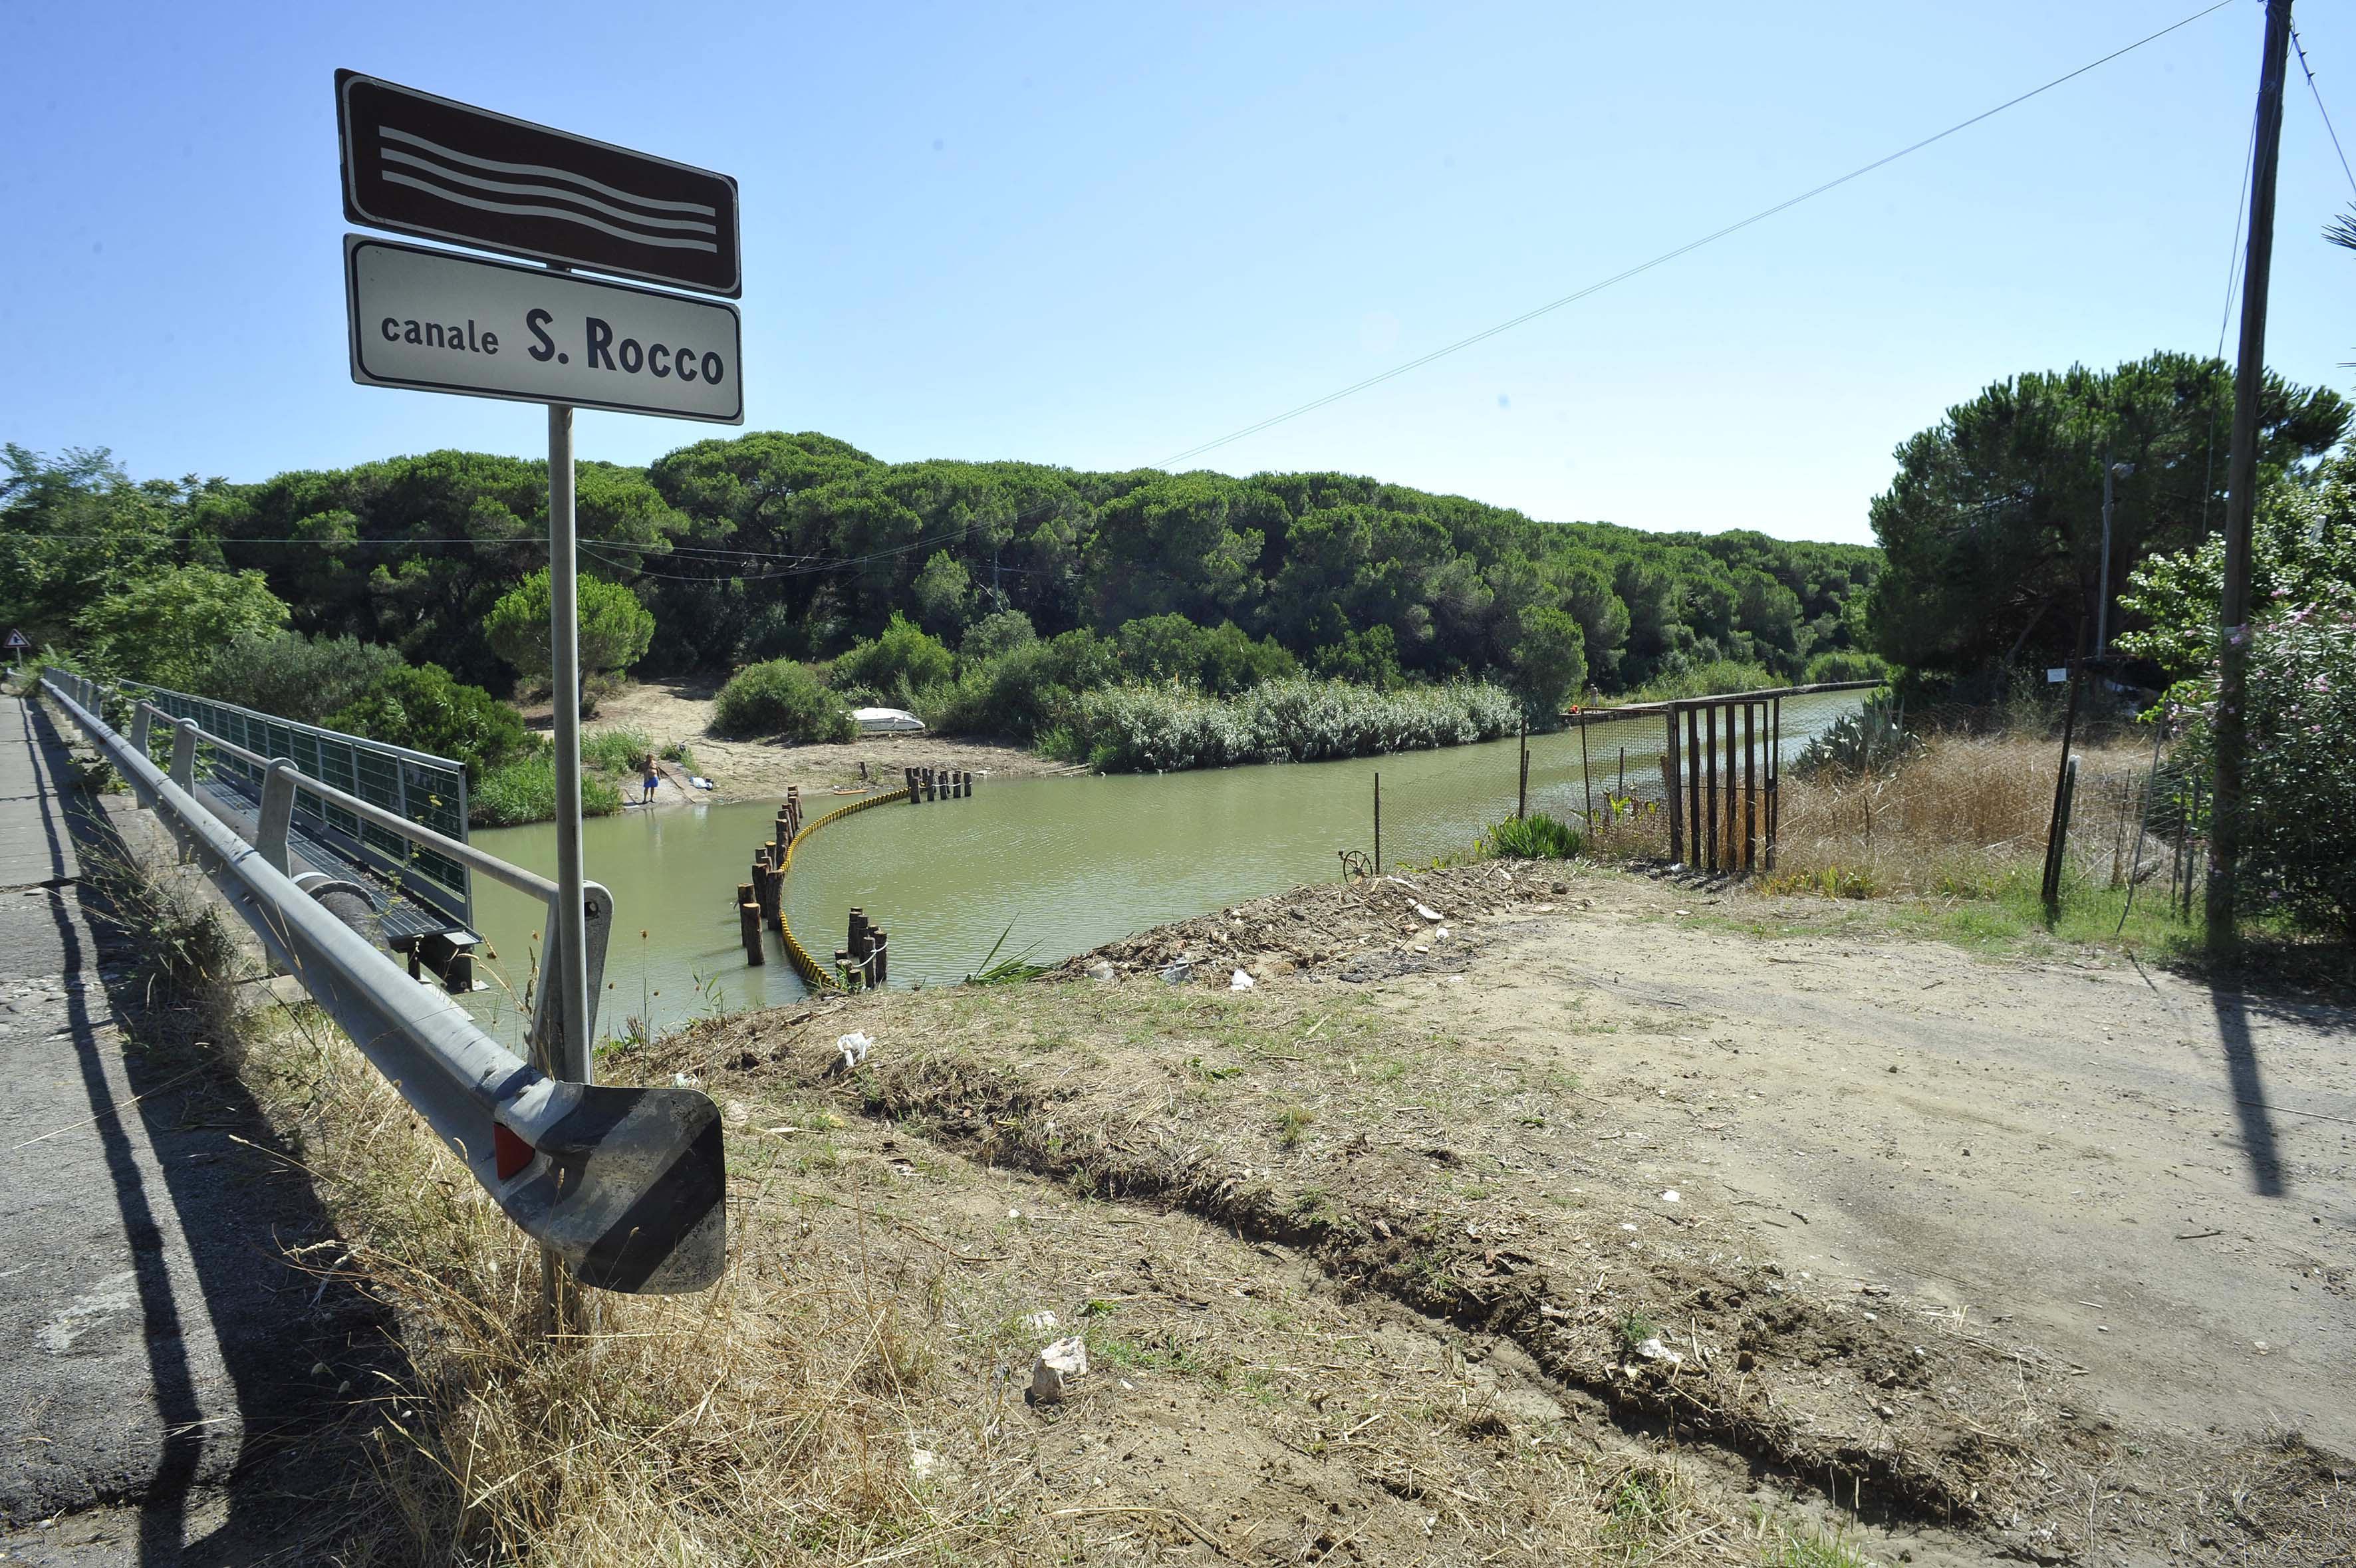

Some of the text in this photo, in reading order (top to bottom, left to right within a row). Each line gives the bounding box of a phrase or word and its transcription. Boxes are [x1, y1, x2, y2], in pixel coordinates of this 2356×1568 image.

[381, 308, 724, 385] canale S. Rocco
